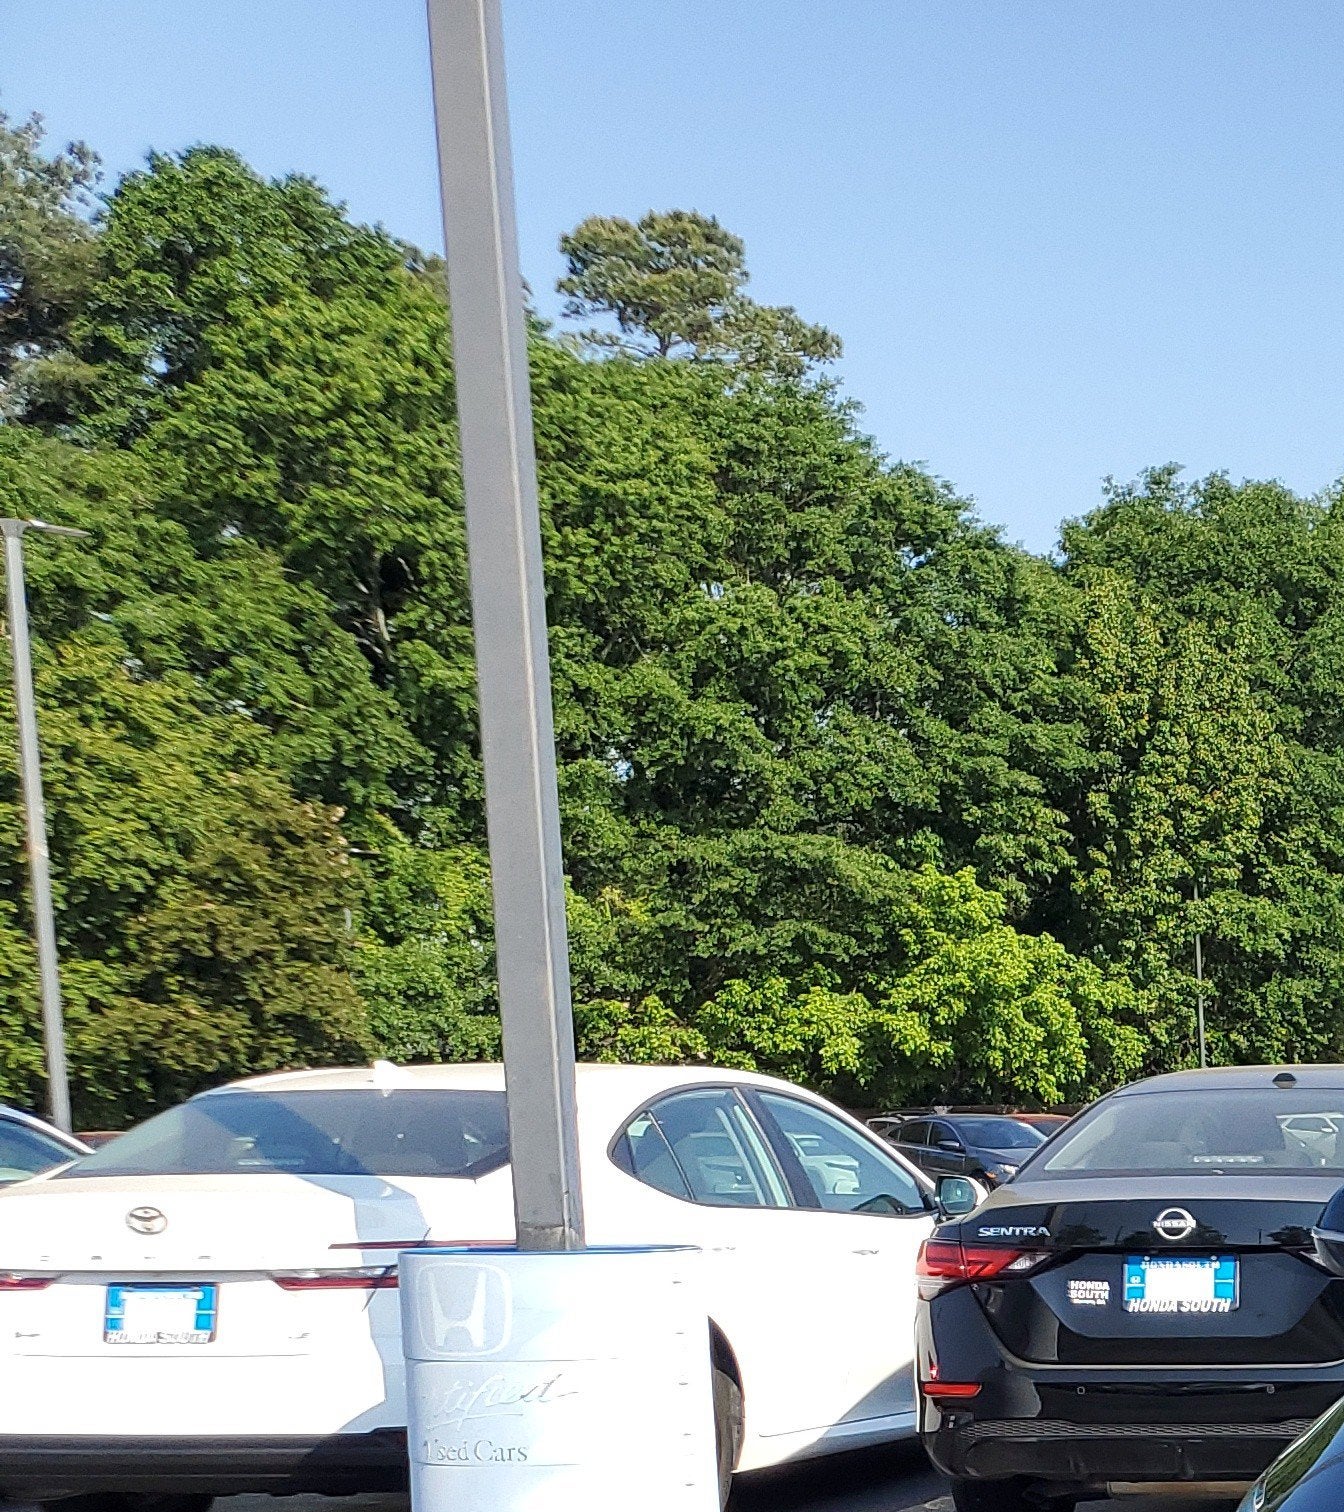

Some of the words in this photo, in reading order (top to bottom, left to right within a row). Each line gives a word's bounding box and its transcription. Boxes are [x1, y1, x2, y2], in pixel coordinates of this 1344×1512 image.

[977, 1226, 1051, 1237] SENTRA
[1069, 1280, 1110, 1291] HONDA
[1068, 1290, 1109, 1300] SOUTH
[1128, 1298, 1178, 1313] HONDA
[1180, 1298, 1232, 1313] SOUTH
[474, 1439, 529, 1462] Cars
